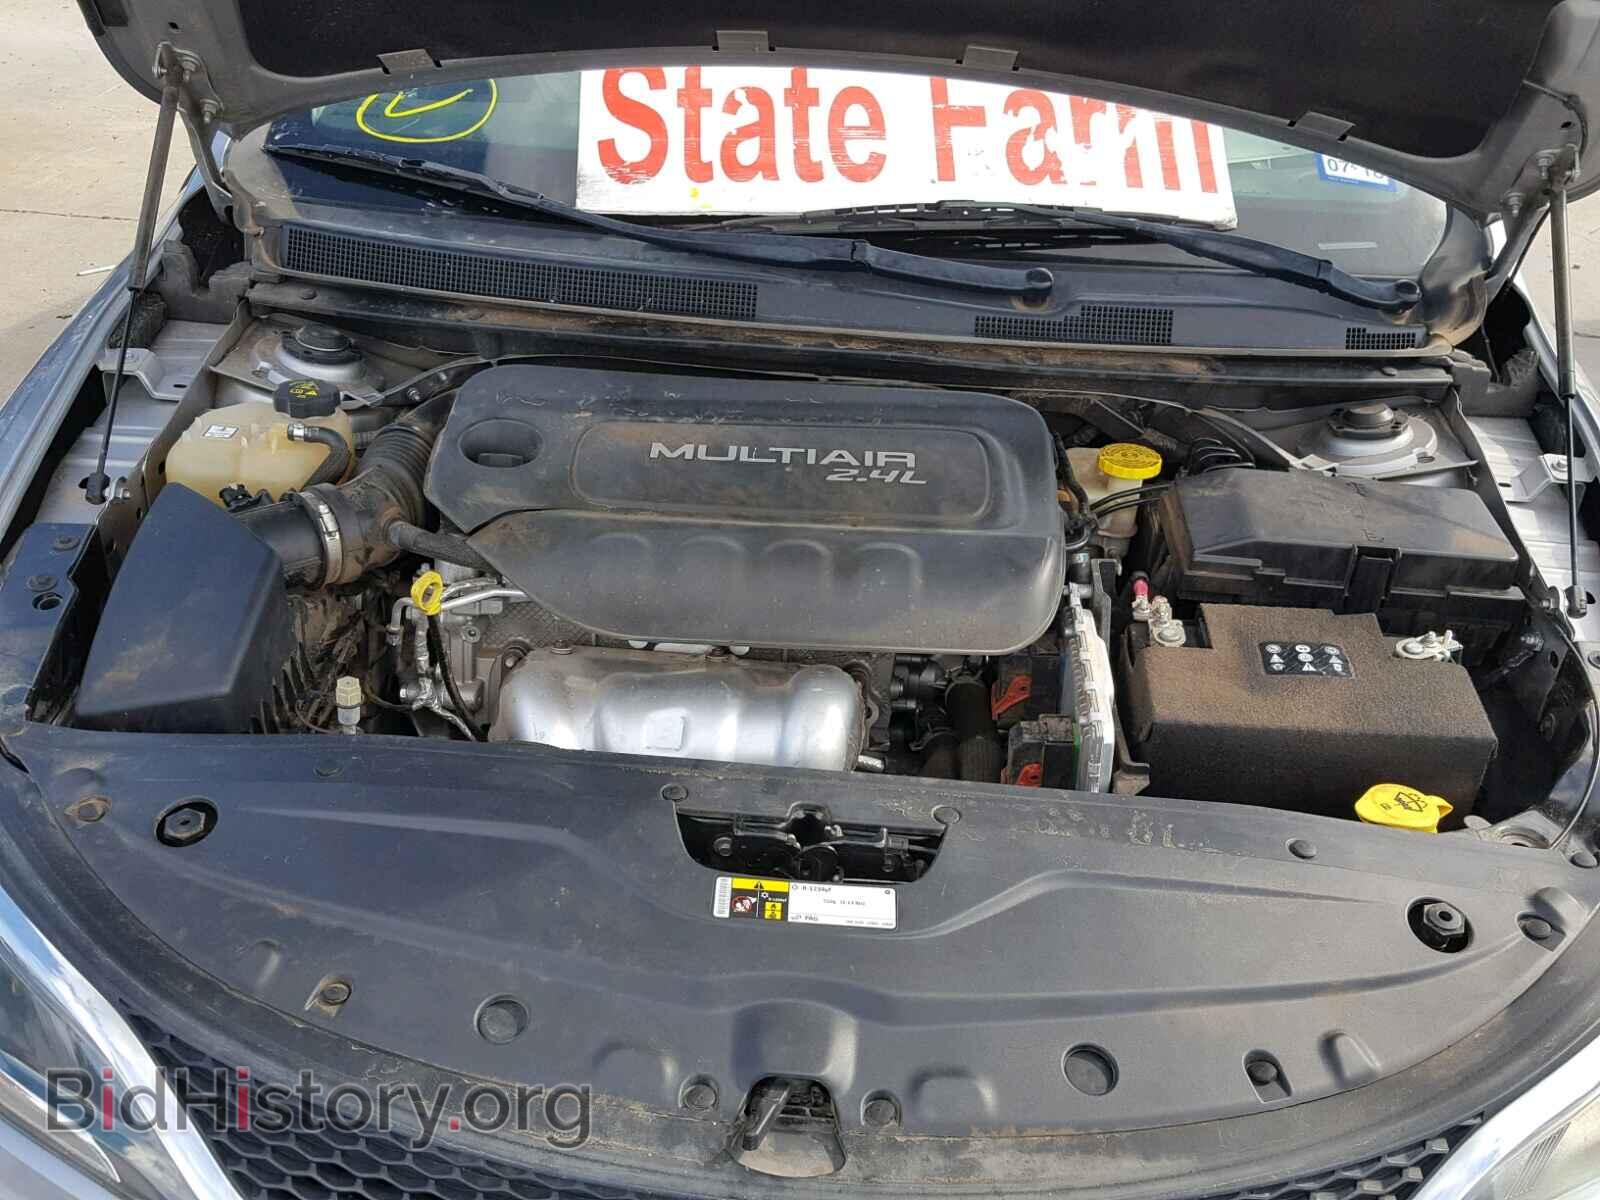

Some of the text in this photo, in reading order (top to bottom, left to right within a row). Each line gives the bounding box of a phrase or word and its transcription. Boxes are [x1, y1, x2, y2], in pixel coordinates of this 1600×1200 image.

[597, 66, 887, 185] State
[649, 442, 916, 467] MULTIAIR
[825, 468, 927, 484] 2.4L
